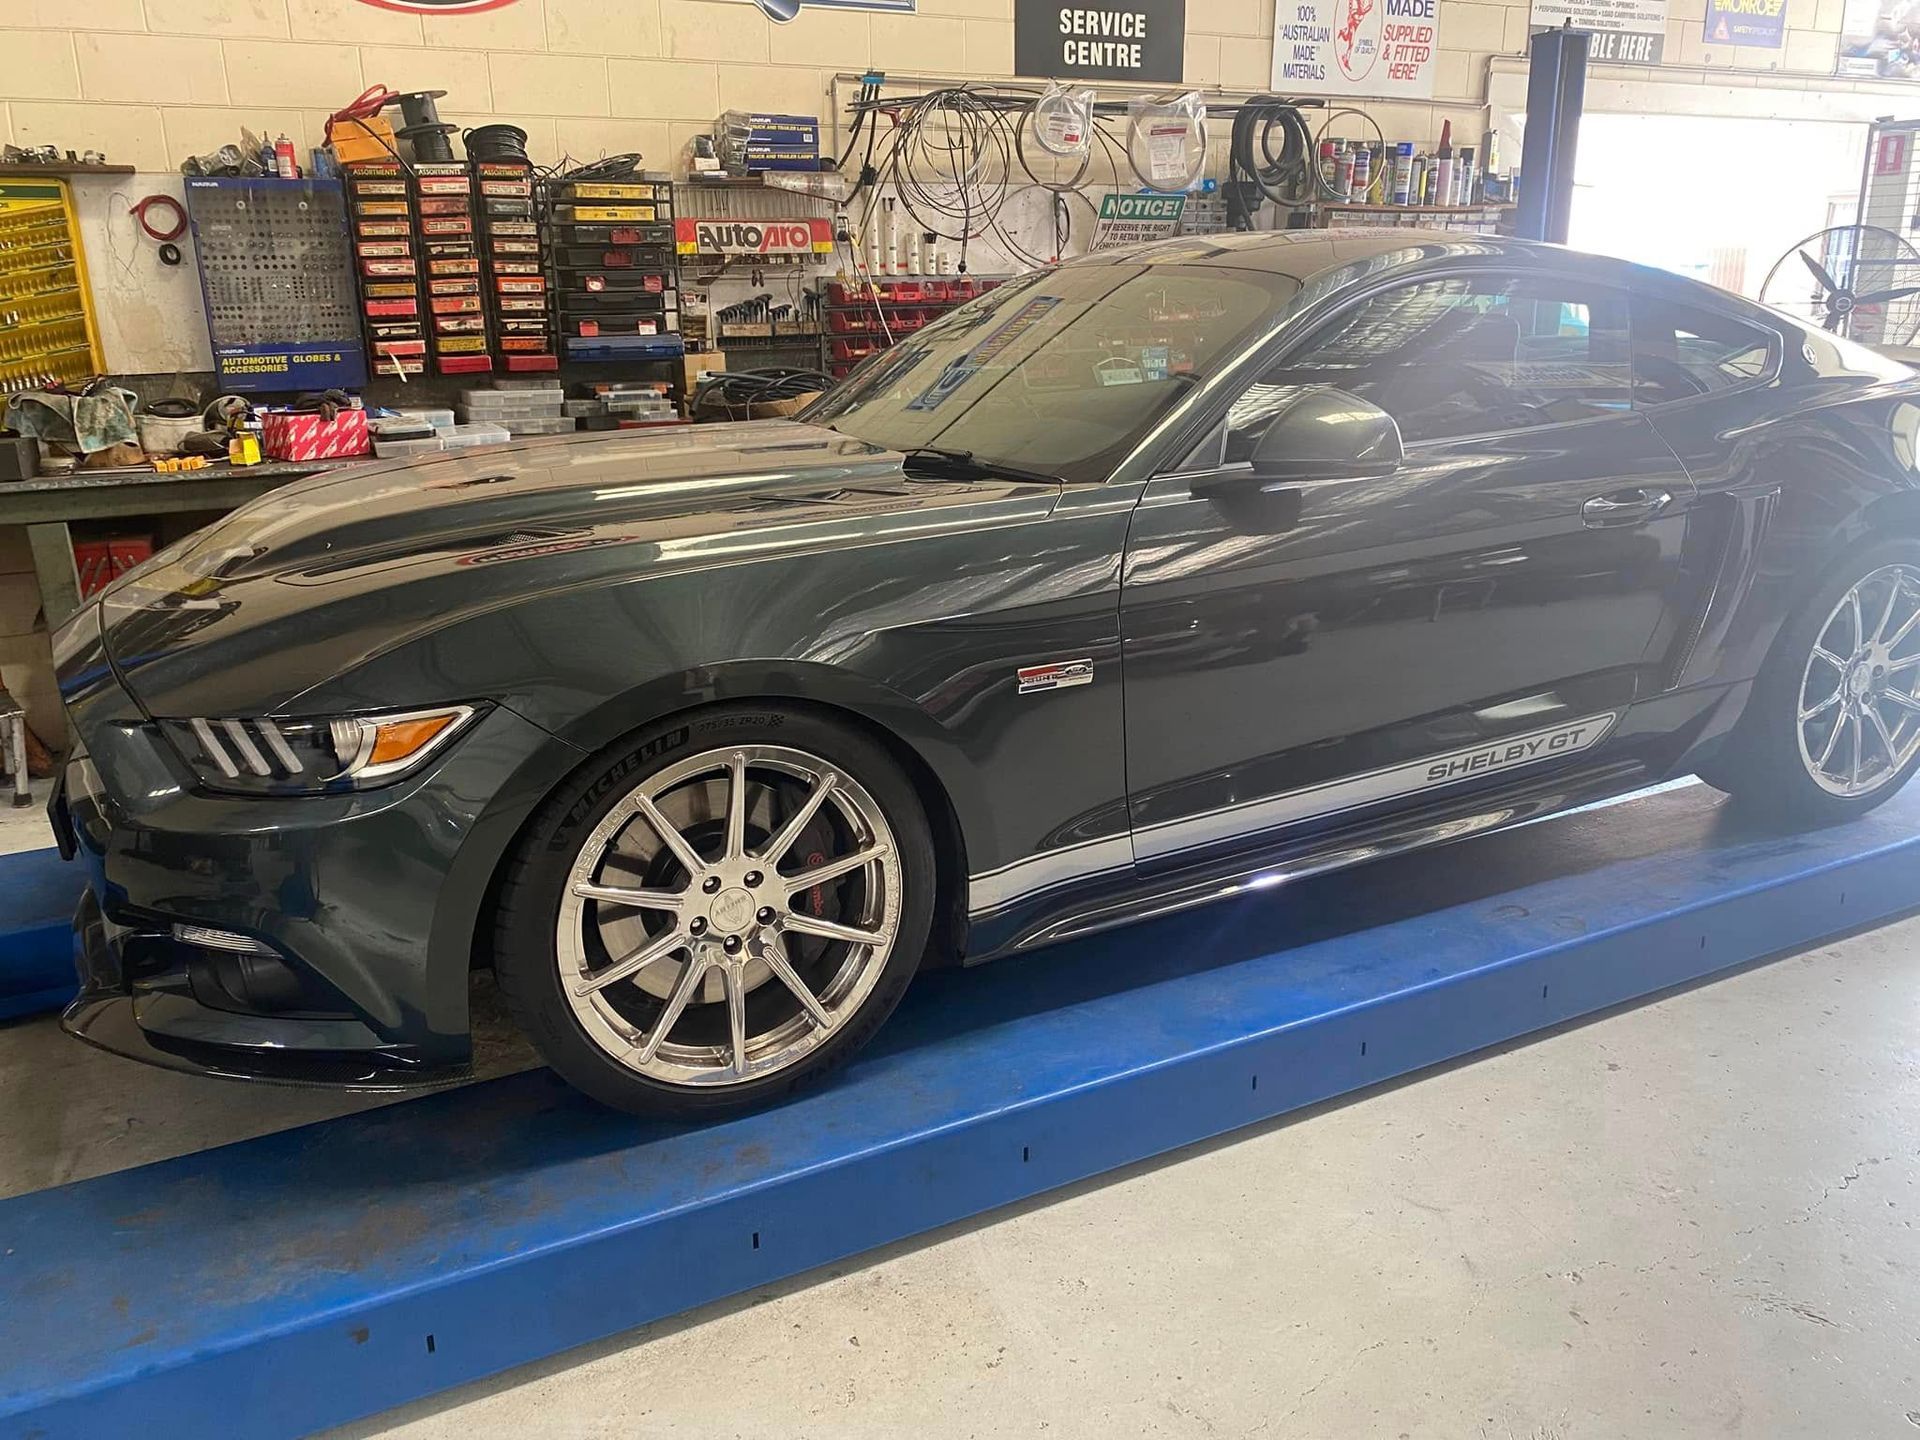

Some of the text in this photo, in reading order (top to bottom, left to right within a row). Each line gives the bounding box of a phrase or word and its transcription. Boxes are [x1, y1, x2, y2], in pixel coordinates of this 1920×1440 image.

[1297, 6, 1316, 22] 100%
[1386, 0, 1434, 18] MADE
[1060, 8, 1146, 38] SERVICE
[1383, 24, 1433, 43] SUPPLIED
[1063, 40, 1141, 68] CENTRE
[1393, 46, 1430, 63] FITTED
[1618, 35, 1654, 61] HERE
[1283, 63, 1326, 81] MATERIALS
[1387, 63, 1419, 81] HERE!
[353, 168, 397, 176] ASSORTMENTS
[418, 168, 461, 176] ASSORTMENTS
[483, 168, 524, 176] ASSORTMENTS
[1106, 198, 1180, 216] NOTICE!
[1140, 224, 1152, 232] THE
[221, 353, 342, 366] AUTOMOTIVE GLOBES &
[223, 363, 289, 375] ACCESSORIES
[1426, 728, 1587, 783] SHELBY GT
[569, 728, 684, 823] MICHELIN
